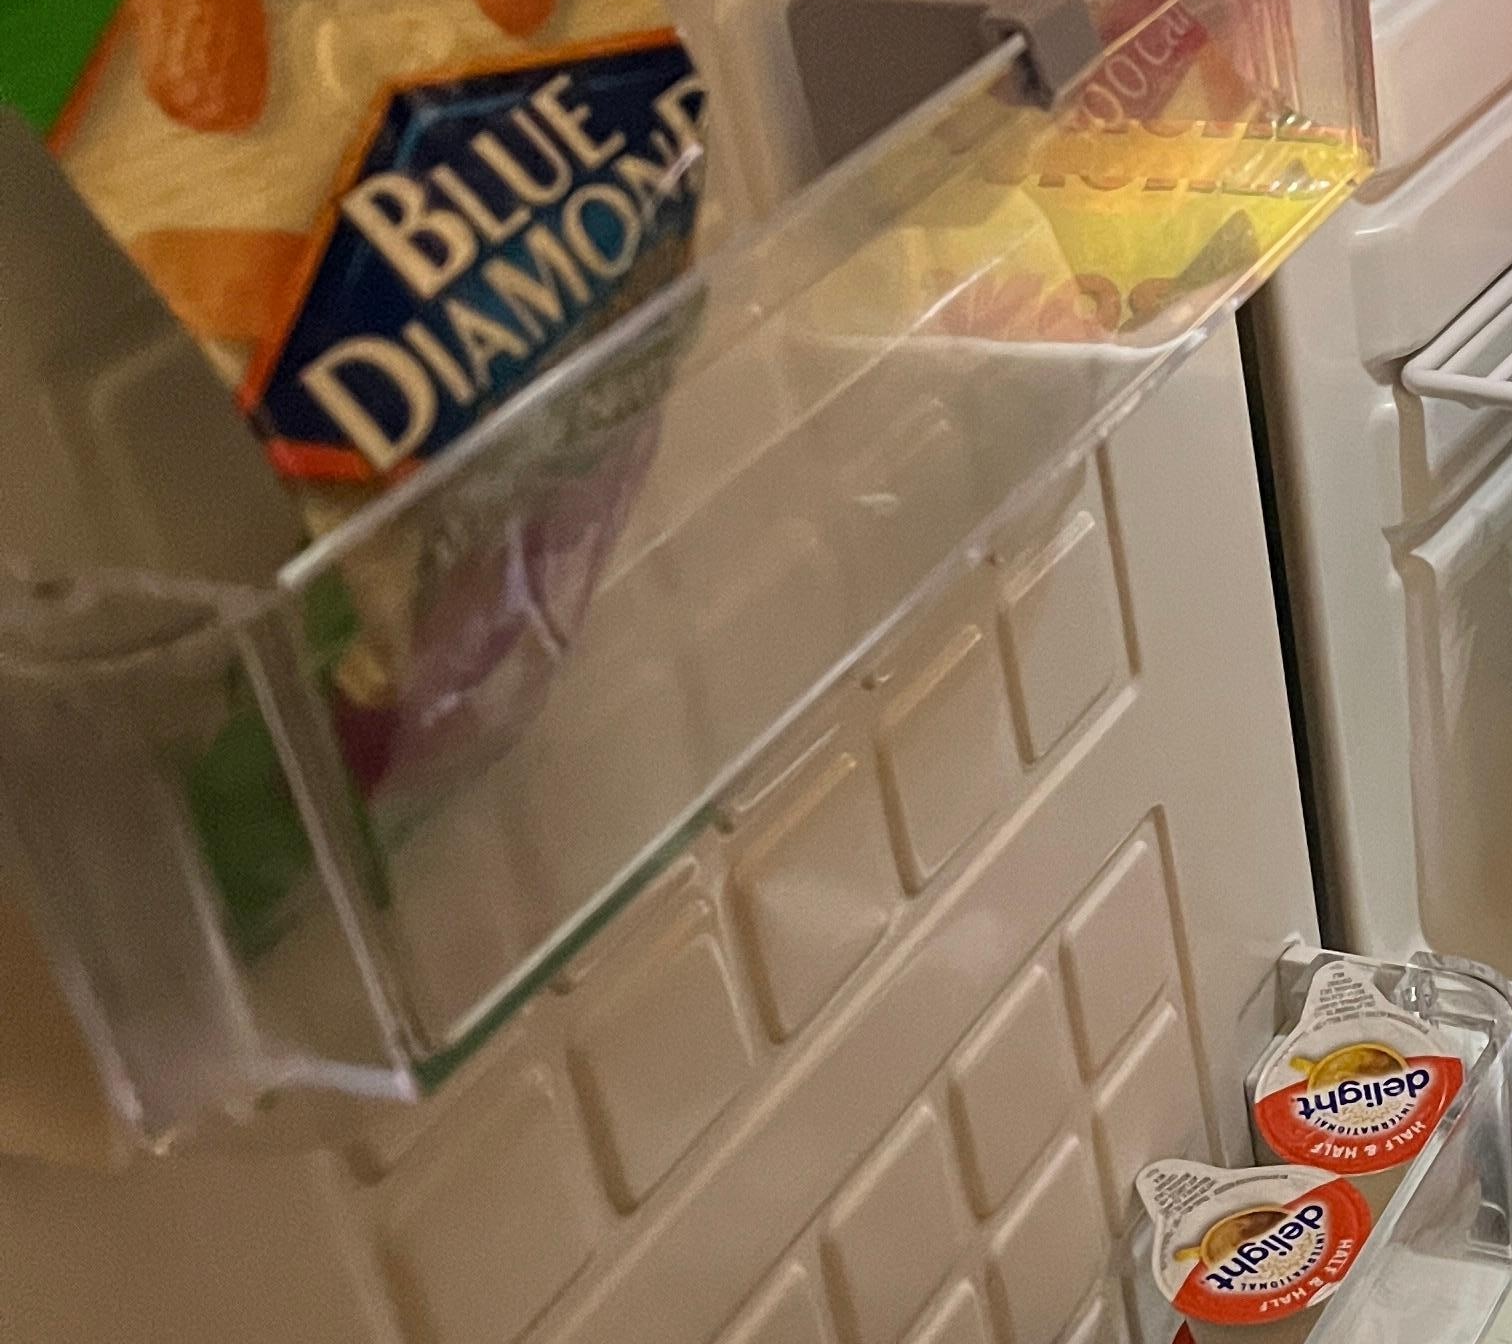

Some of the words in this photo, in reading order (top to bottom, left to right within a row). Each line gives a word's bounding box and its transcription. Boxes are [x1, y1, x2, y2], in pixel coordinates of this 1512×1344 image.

[341, 73, 628, 301] BLUE
[302, 76, 706, 473] DIAMOND
[1293, 1068, 1430, 1120] delight
[1313, 1102, 1416, 1136] INTERNATIONAL
[1385, 1119, 1427, 1151] HALF
[1310, 1141, 1358, 1160] HALF
[1363, 1143, 1378, 1157] &
[1205, 1205, 1323, 1290] delight
[1240, 1231, 1327, 1292] INTERNATIONAL
[1323, 1238, 1354, 1276] HALF
[1258, 1287, 1309, 1313] HALF
[1308, 1277, 1324, 1288] &
